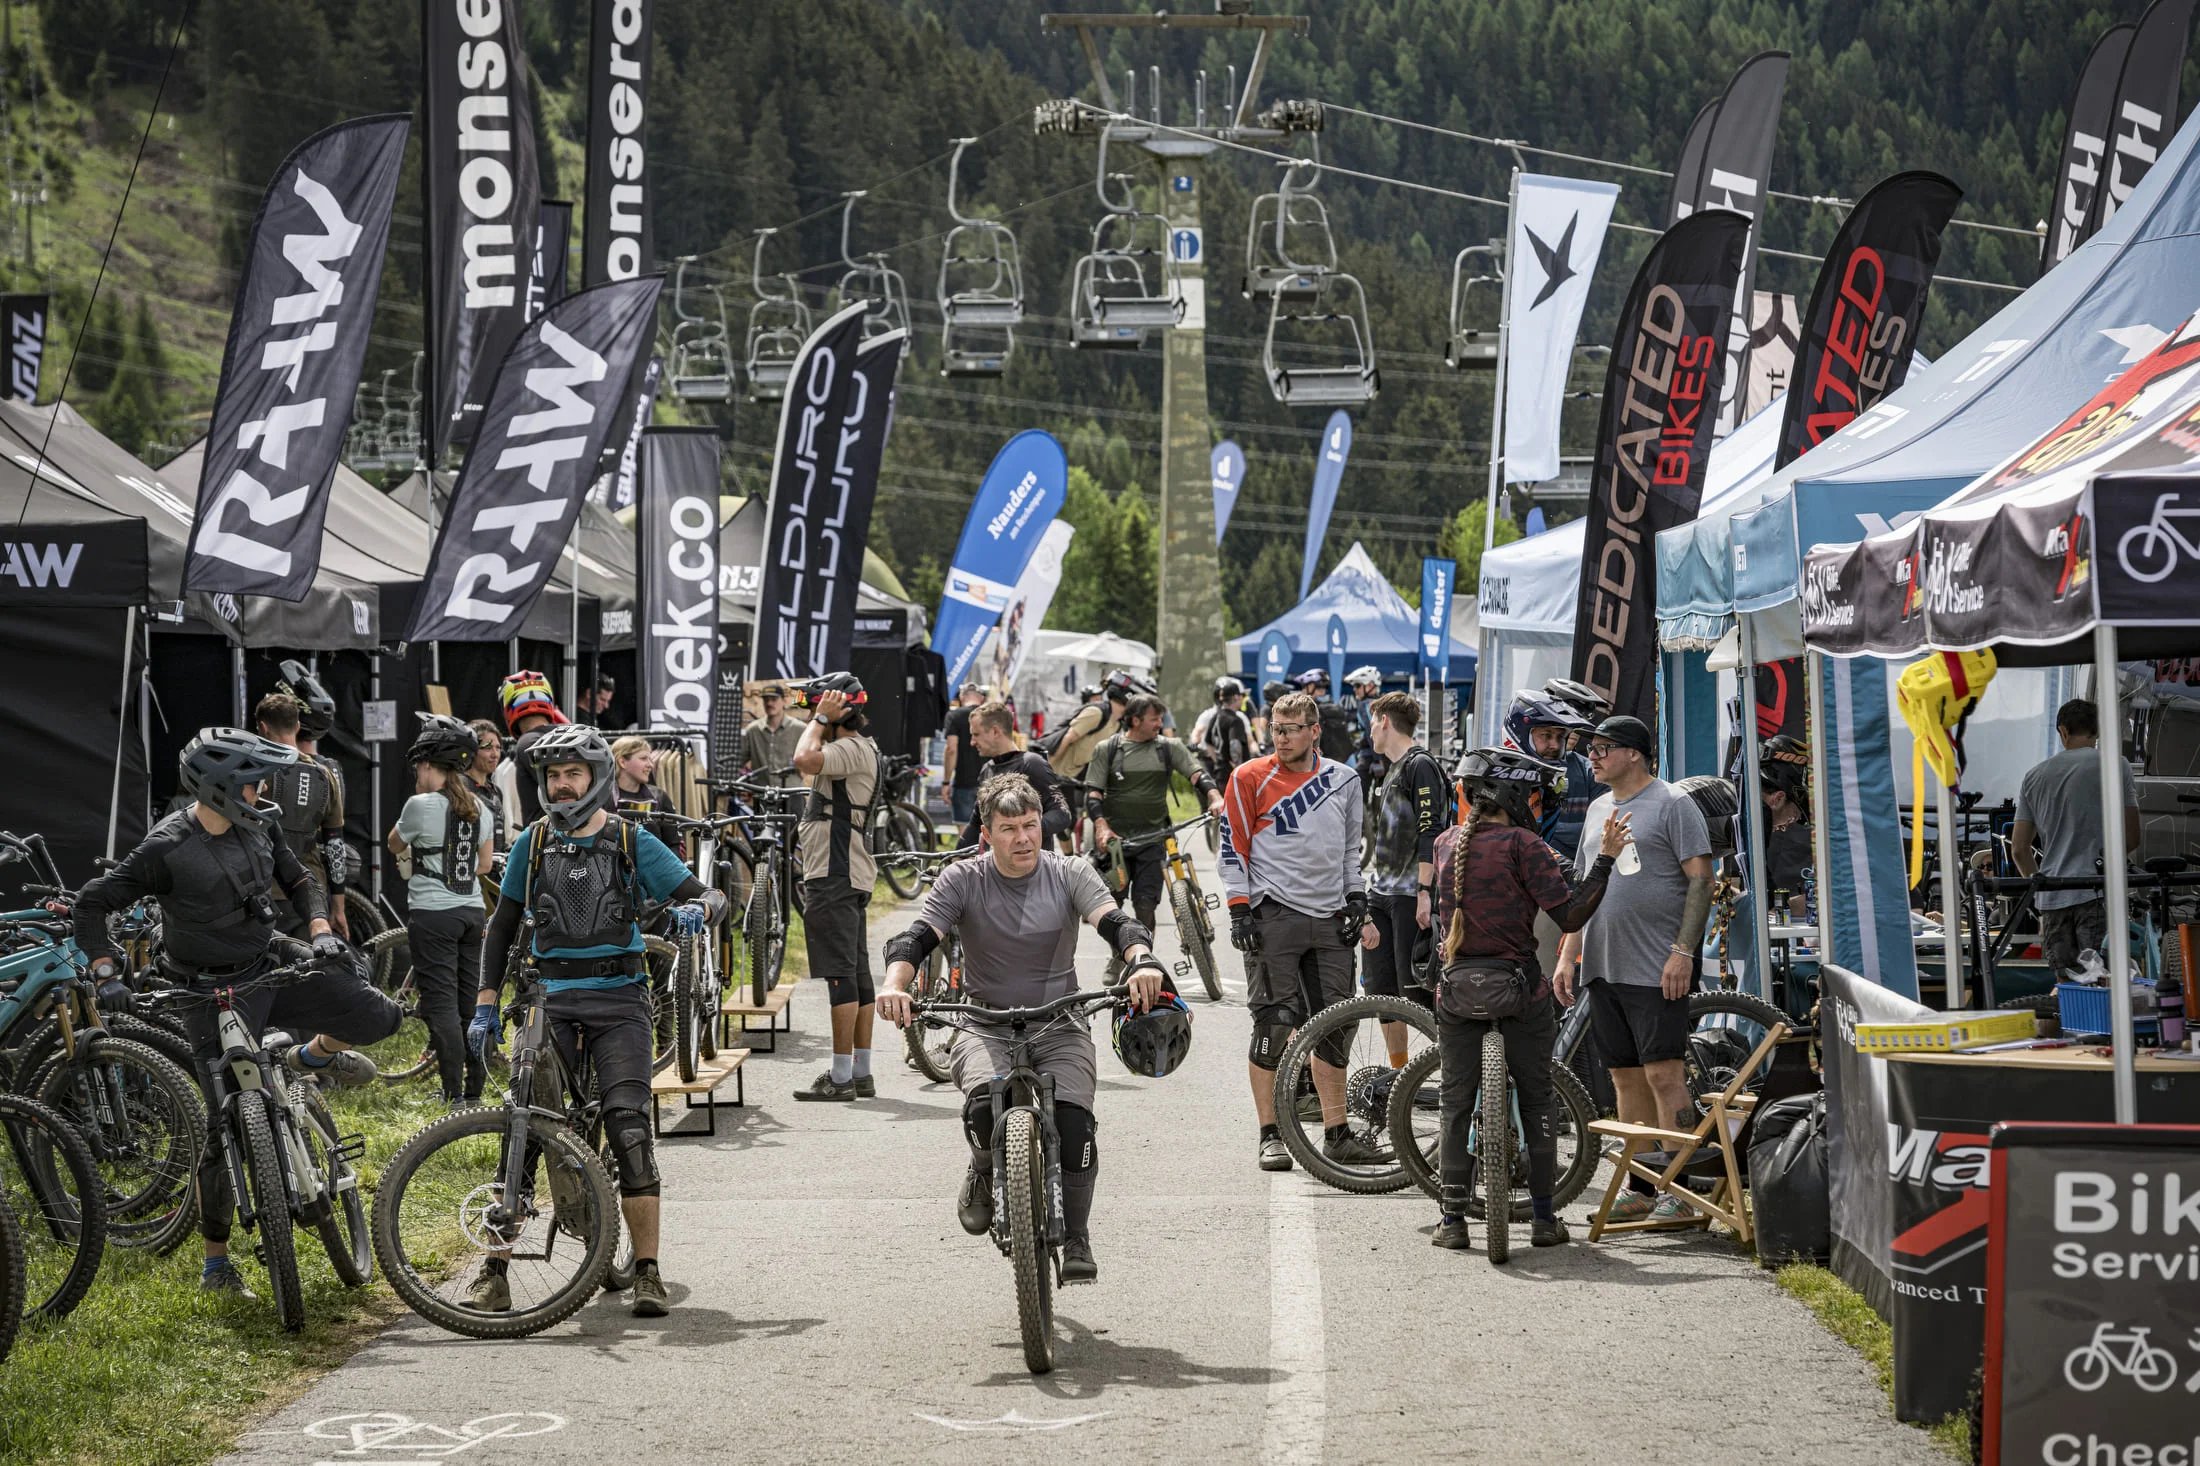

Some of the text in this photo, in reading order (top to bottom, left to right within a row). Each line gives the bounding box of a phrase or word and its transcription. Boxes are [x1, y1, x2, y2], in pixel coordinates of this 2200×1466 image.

[1801, 246, 1885, 452] ATED
[1652, 335, 1715, 486] BIKES
[987, 470, 1038, 541] Nauders
[1583, 283, 1687, 715] DEDICATED
[1431, 569, 1447, 629] deuter
[1289, 1064, 1300, 1091] SWISS
[1543, 1115, 1551, 1137] FOX
[2052, 1242, 2199, 1281] Servi
